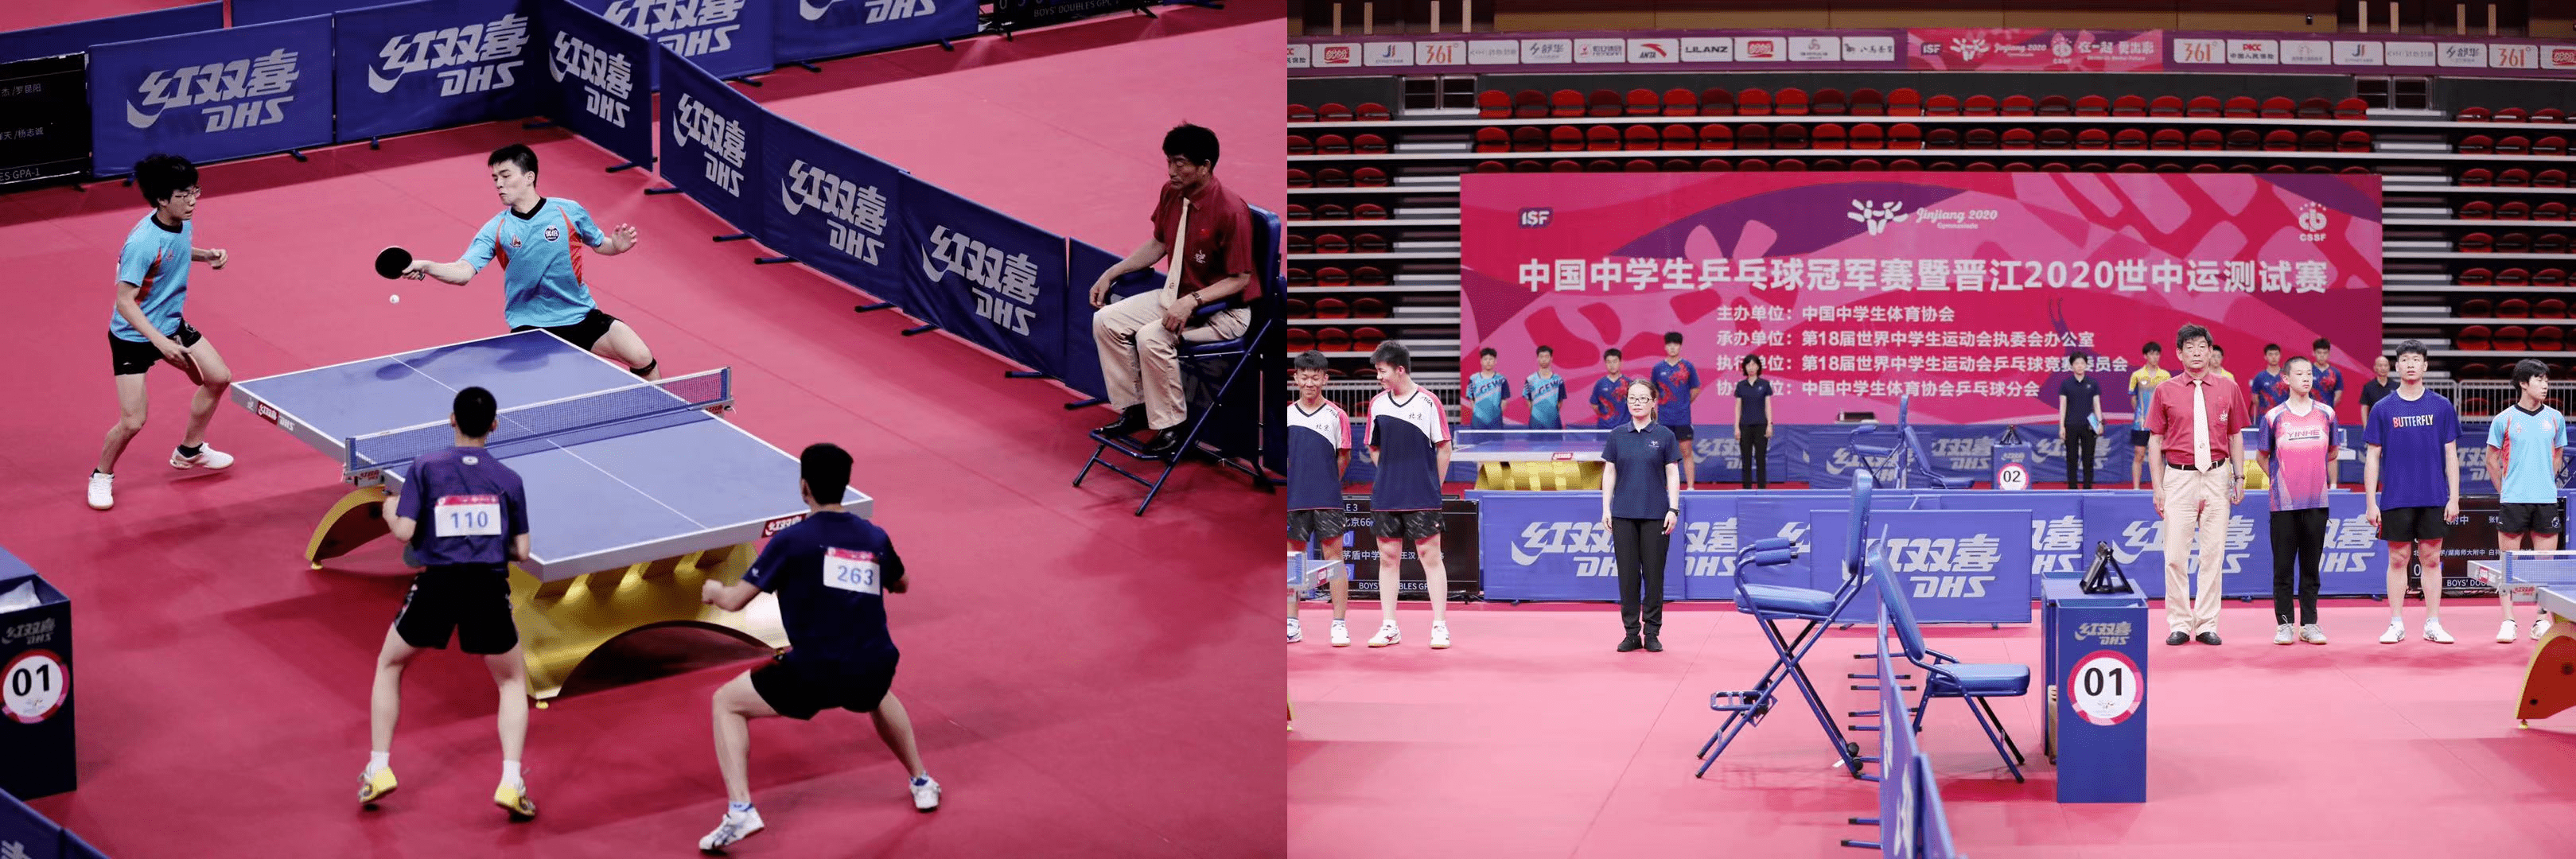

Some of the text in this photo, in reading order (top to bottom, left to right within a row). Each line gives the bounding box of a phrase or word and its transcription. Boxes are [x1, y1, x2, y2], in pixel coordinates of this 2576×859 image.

[368, 13, 530, 93] 红双喜
[549, 30, 636, 100] 红双喜
[1923, 45, 1941, 54] ISF
[127, 49, 300, 128] 红双喜
[437, 60, 524, 97] DHS
[201, 95, 294, 133] DHS
[583, 85, 631, 128] DHS
[673, 92, 746, 169] 红双喜
[704, 151, 745, 198] DHS
[781, 159, 888, 235] 红双喜
[1916, 207, 1998, 223] Jinjiang 2020
[1521, 211, 1550, 225] ISF
[827, 219, 885, 266] DHS
[921, 224, 1040, 305] 红双喜
[1519, 257, 2328, 293] 中国中学生乒乓球冠军赛暨晋江2020世中运测试赛
[971, 287, 1037, 336] DHS
[2392, 414, 2434, 429] BUTTERFLY
[2002, 470, 2021, 483] 02
[450, 511, 488, 529] 110
[837, 566, 874, 586] 263
[1909, 576, 1996, 598] DHS
[2075, 621, 2132, 640] 红双喜
[12, 663, 50, 697] 01
[2084, 667, 2123, 696] 01
